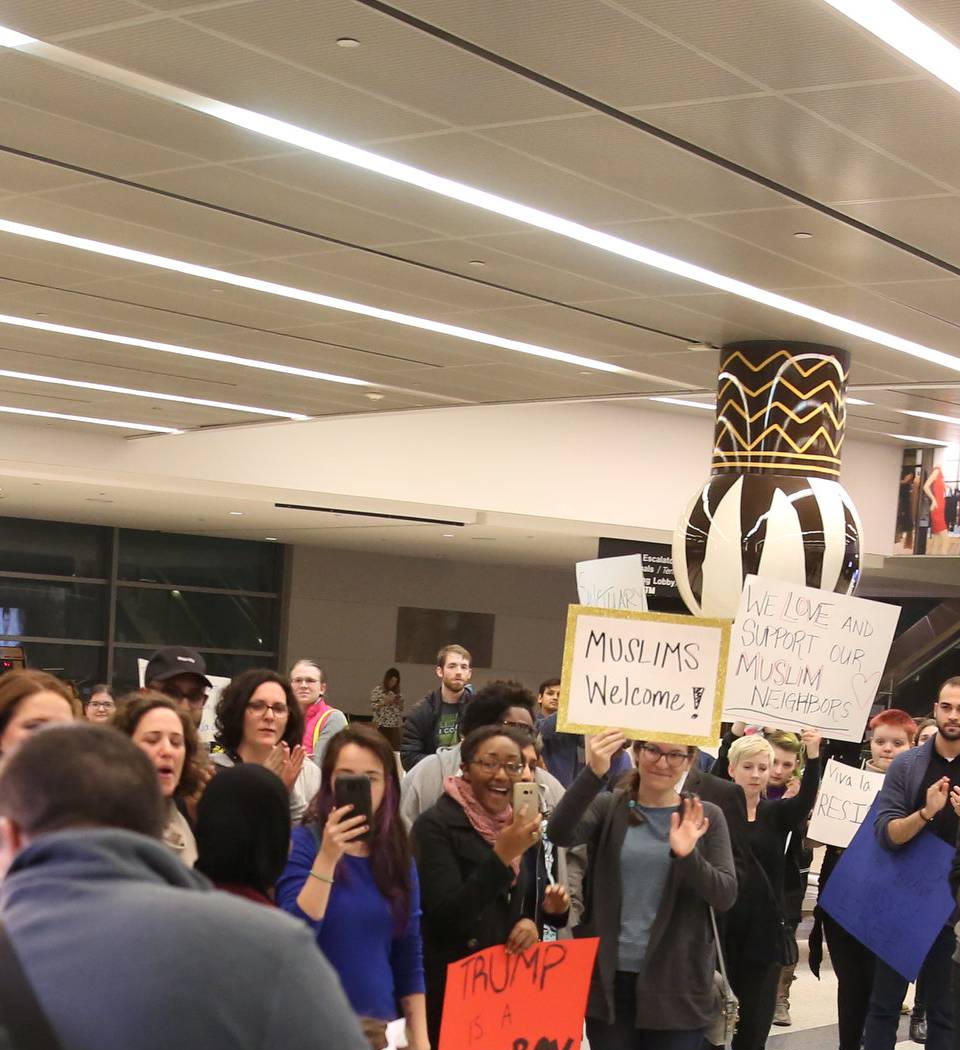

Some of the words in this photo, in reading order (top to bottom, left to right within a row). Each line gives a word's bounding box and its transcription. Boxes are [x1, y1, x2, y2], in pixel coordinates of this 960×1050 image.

[642, 554, 673, 564] Escalato
[746, 584, 779, 617] WE
[782, 591, 834, 628] LOVE
[841, 616, 874, 638] AND
[585, 630, 700, 672] MUSLIMS
[741, 618, 819, 660] SUPPORT
[830, 644, 866, 673] OUR
[736, 653, 824, 692] MUSLIM
[751, 685, 853, 721] NEIGHBORS
[860, 774, 871, 792] la
[817, 793, 867, 824] RESI
[460, 943, 567, 1000] TRUMP
[469, 1014, 484, 1045] IS
[500, 1003, 512, 1030] A
